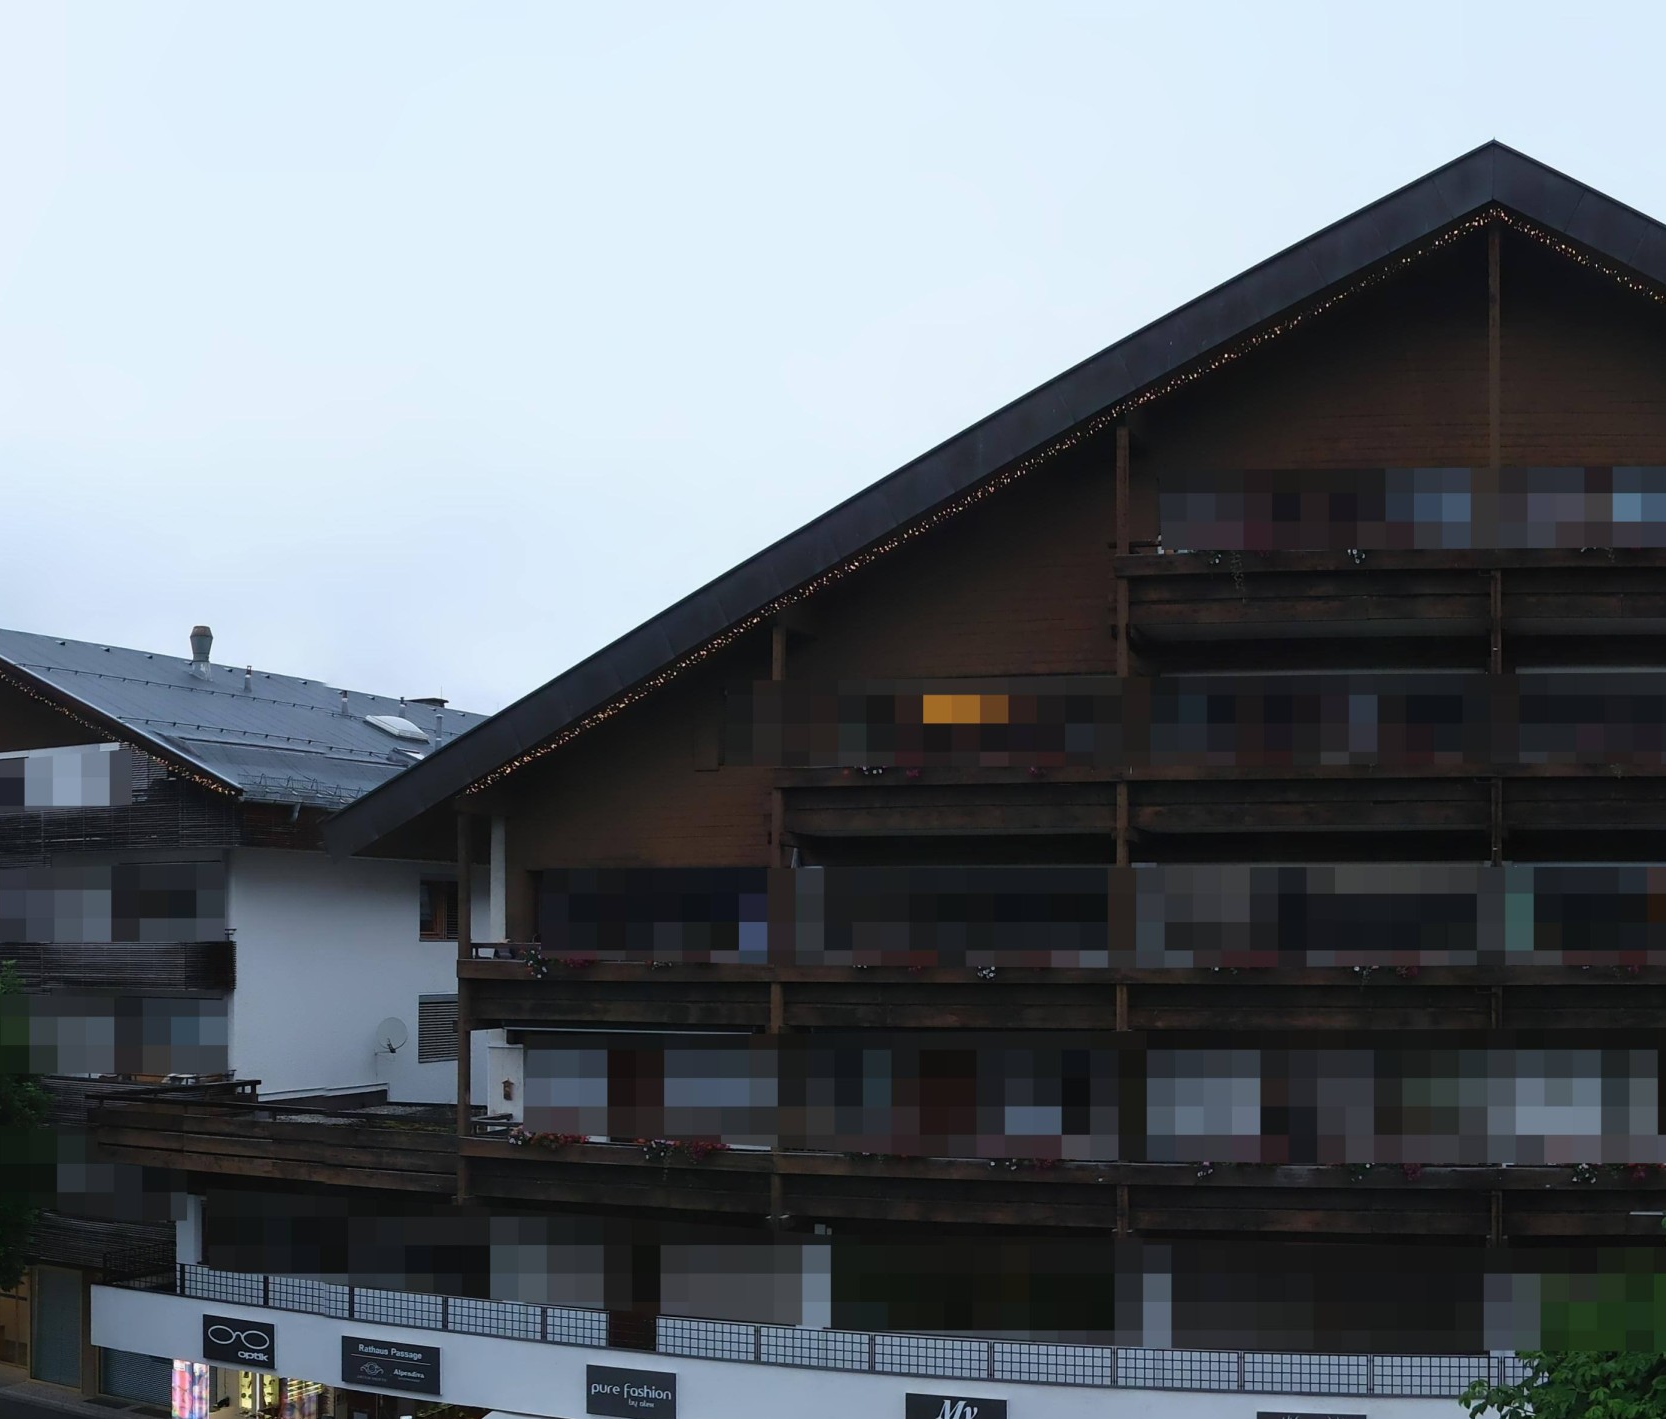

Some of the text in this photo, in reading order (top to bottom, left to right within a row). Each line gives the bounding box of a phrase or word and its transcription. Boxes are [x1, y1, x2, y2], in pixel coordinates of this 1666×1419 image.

[237, 1349, 269, 1363] optik
[358, 1343, 423, 1361] Rathaus Passage
[591, 1383, 672, 1400] pure fashion
